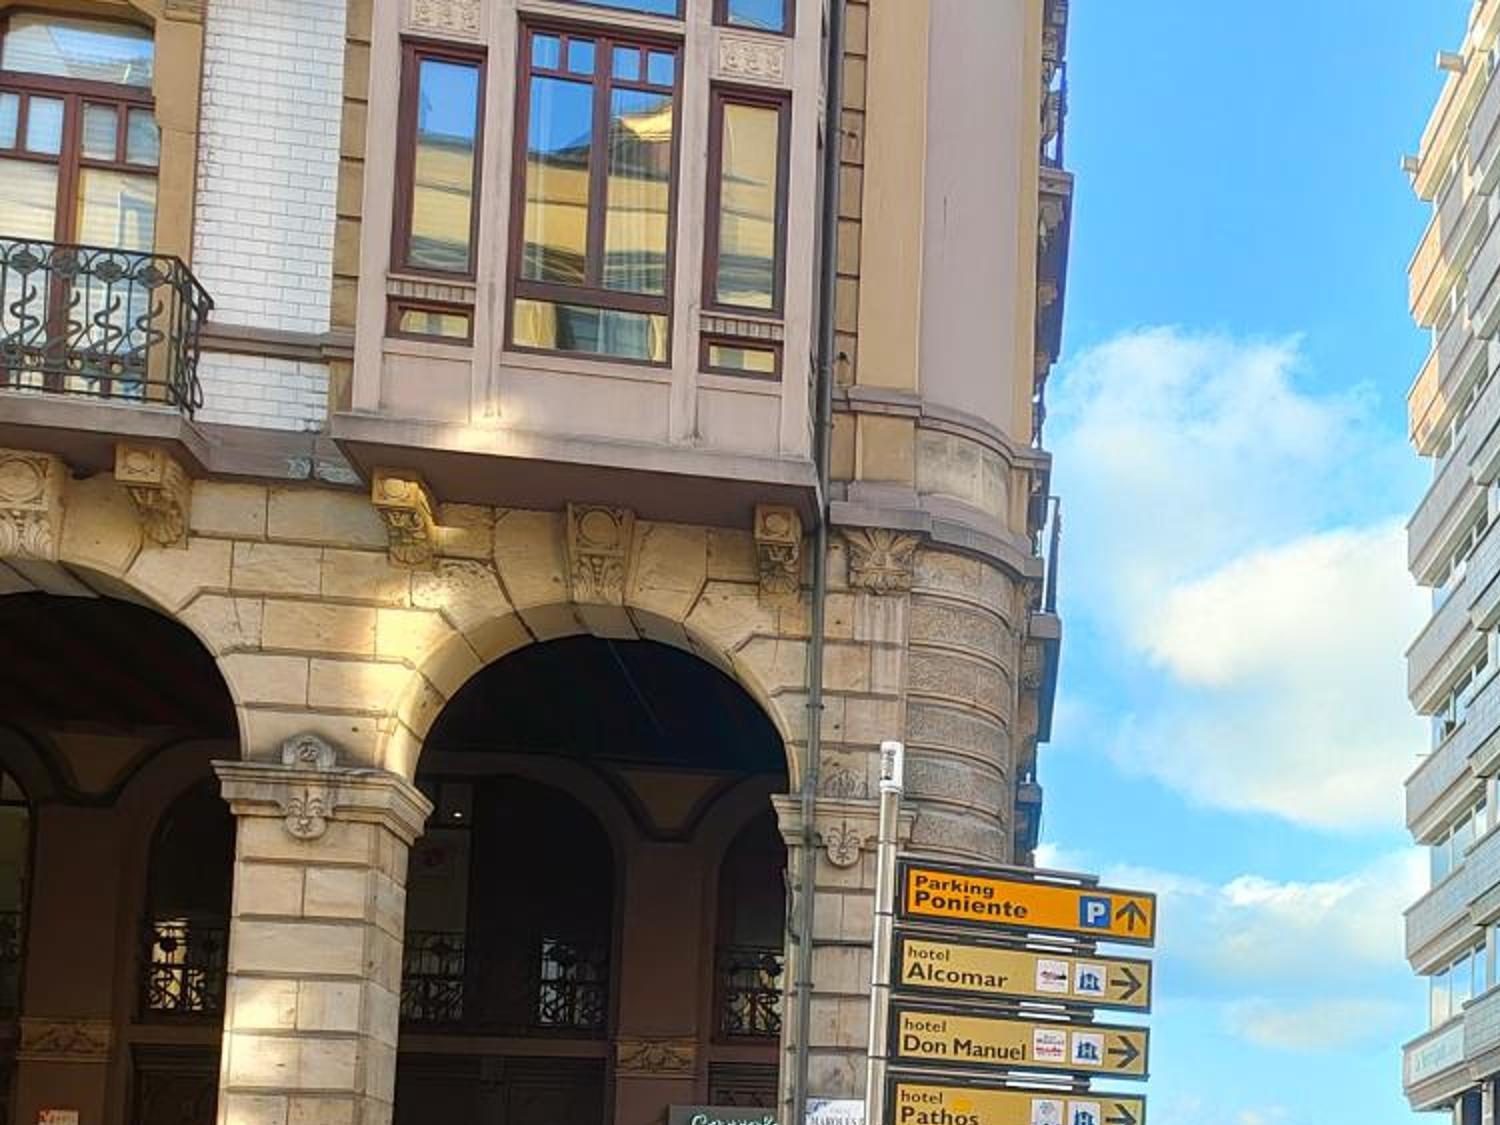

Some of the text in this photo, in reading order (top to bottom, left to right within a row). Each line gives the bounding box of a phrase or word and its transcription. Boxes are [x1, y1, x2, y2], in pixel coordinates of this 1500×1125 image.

[914, 875, 994, 899] Parking
[914, 890, 1106, 925] Poniente P
[907, 945, 950, 961] hotel
[907, 963, 1008, 988] Alcomar
[905, 1018, 947, 1033] hotel
[903, 1034, 947, 1055] Don
[953, 1039, 1027, 1061] Manuel
[900, 1089, 944, 1104] hotel
